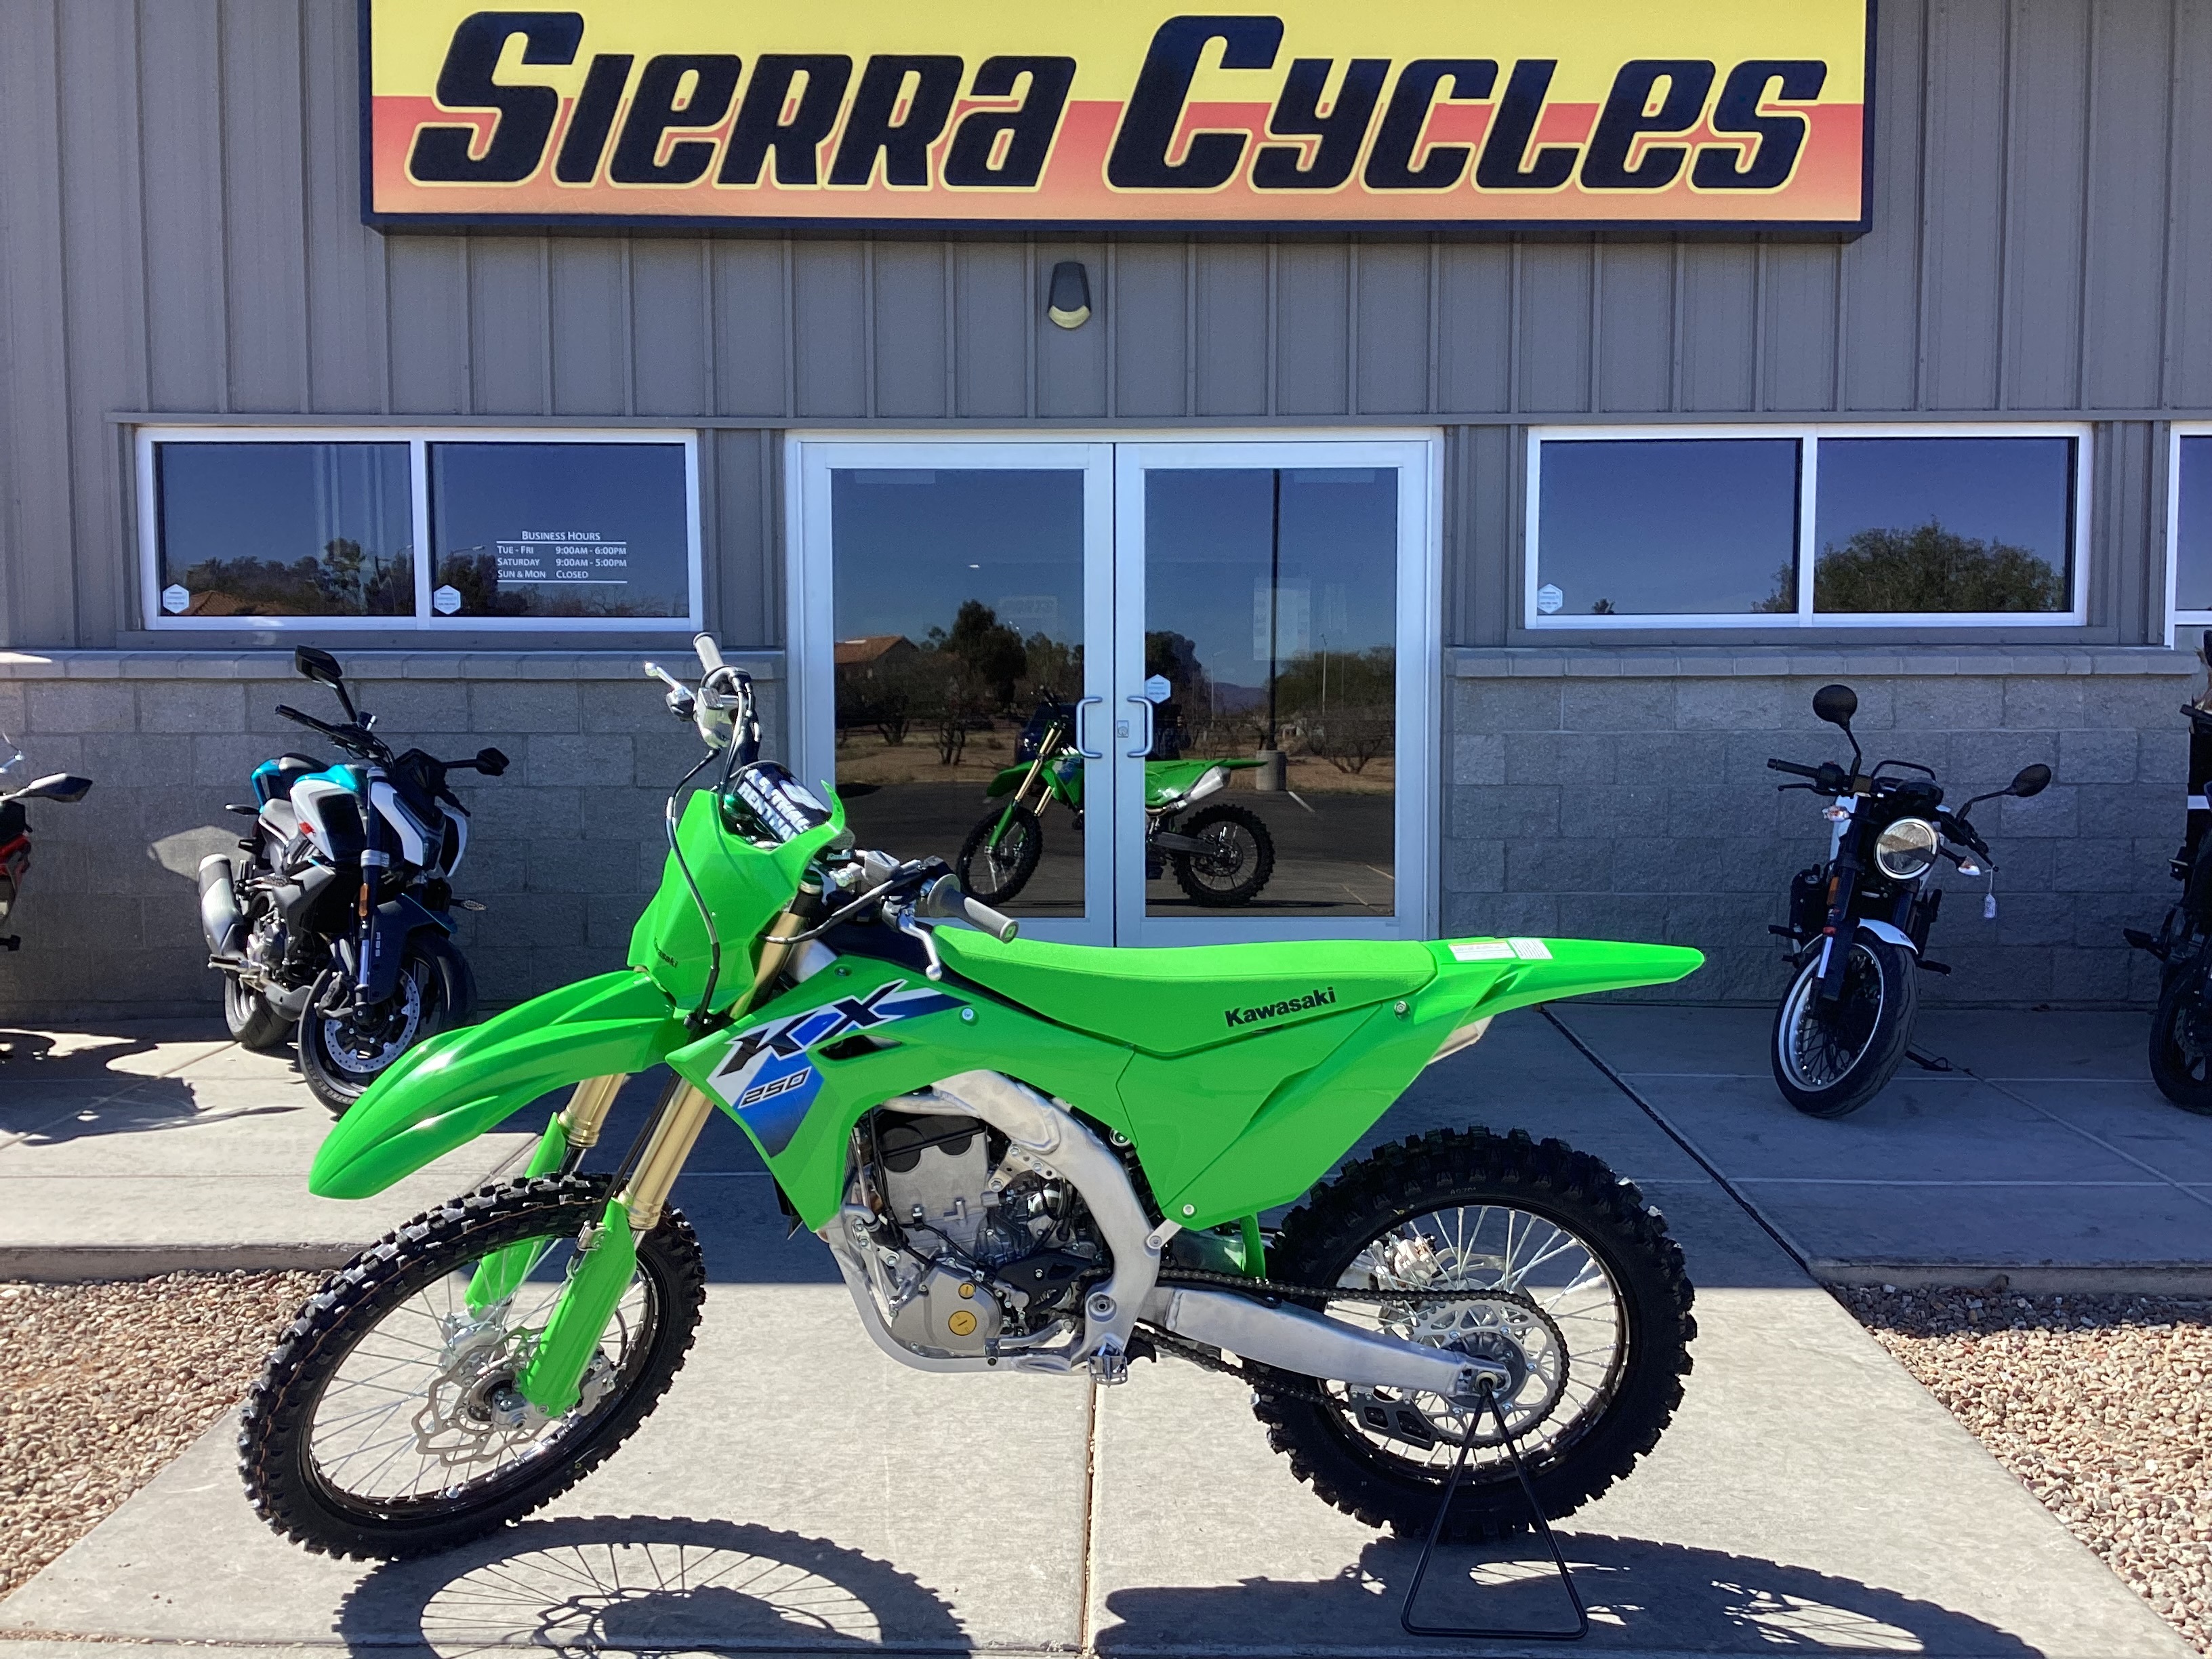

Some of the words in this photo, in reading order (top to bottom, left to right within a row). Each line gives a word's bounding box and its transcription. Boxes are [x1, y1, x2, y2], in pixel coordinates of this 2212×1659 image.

[521, 531, 565, 541] BUSINESS
[568, 531, 601, 541] HOURS
[497, 546, 514, 554] TUE
[520, 546, 534, 554] FRI
[555, 546, 588, 554] 9:00AM
[594, 546, 627, 555] 6:00PM
[497, 557, 540, 567] SATURDAY
[555, 558, 588, 567] 9:00AM
[594, 558, 627, 567] 5:00PM
[497, 570, 516, 579] SUN
[525, 570, 546, 579] MON
[556, 570, 589, 579] CLOSED
[1224, 986, 1336, 1027] Kawasaki
[739, 1067, 811, 1108] 250
